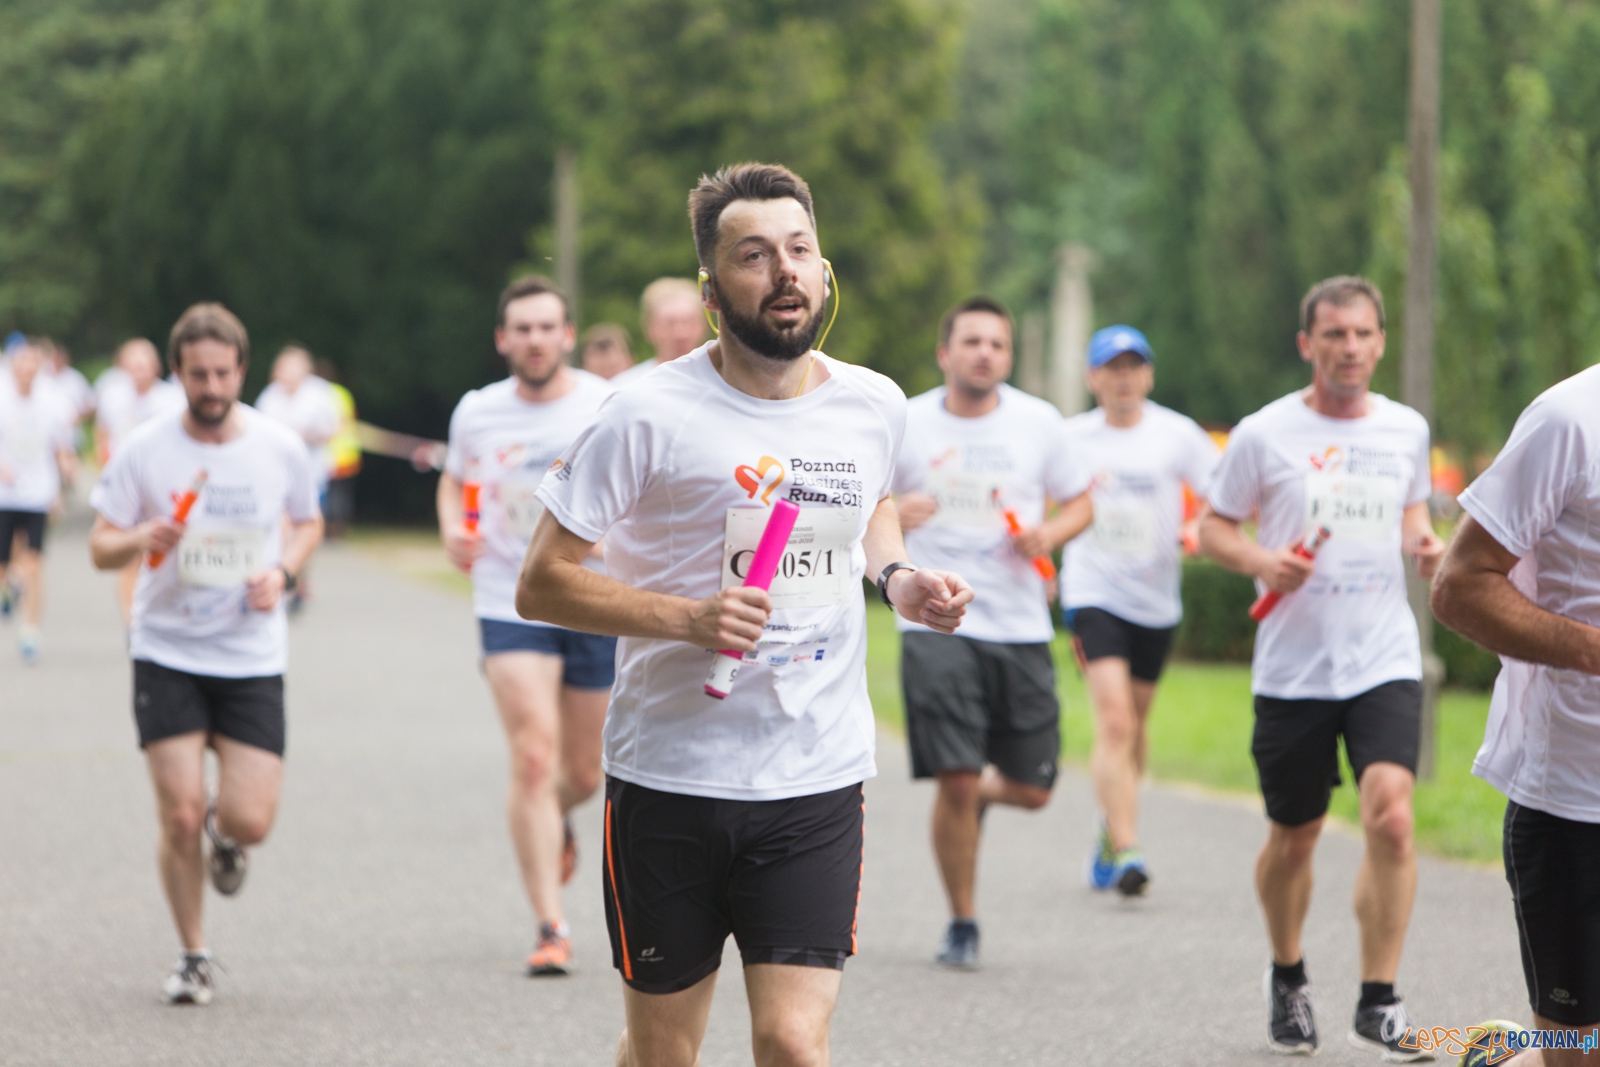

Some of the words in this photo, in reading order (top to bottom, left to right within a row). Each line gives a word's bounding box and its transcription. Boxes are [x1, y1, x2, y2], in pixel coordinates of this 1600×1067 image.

[790, 458, 856, 473] Poznań
[792, 473, 863, 492] Business
[789, 488, 827, 502] Run
